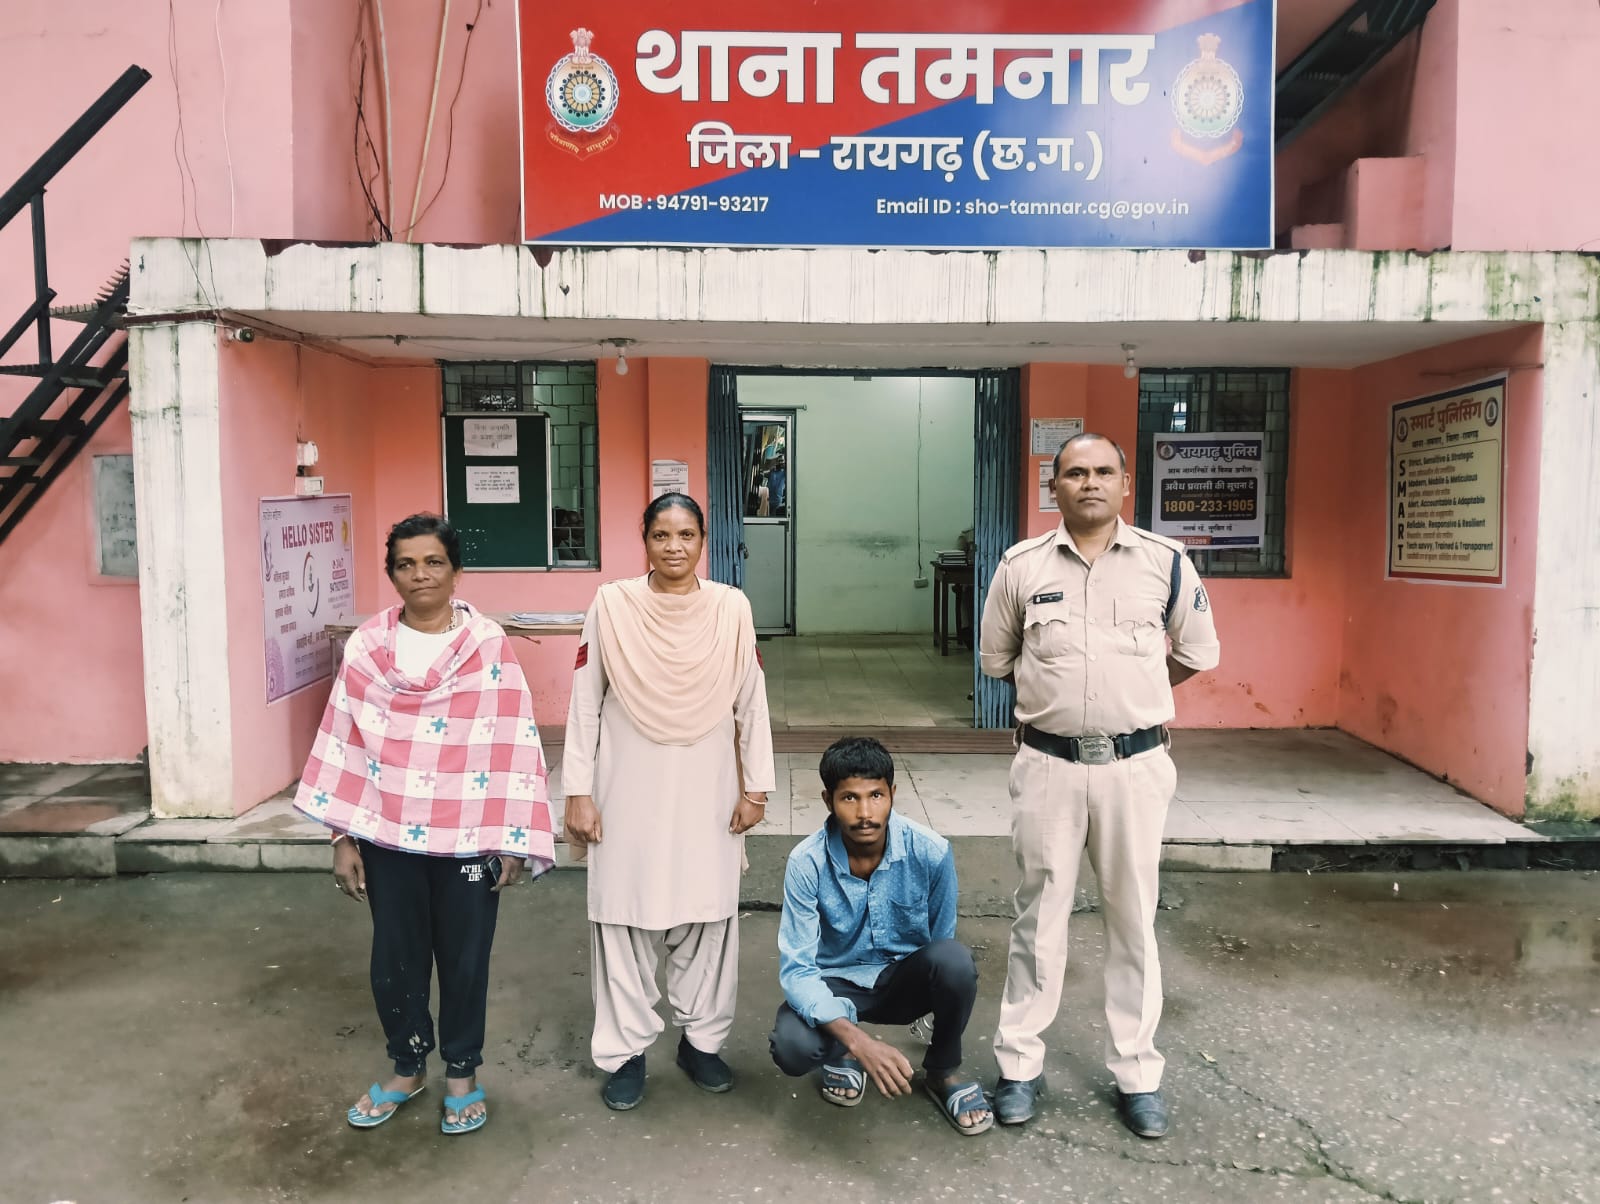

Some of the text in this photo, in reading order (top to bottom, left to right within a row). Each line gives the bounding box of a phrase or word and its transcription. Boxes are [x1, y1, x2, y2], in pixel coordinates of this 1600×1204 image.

[635, 29, 1156, 105] थाना तमनार
[686, 121, 792, 170] जिला
[830, 136, 963, 183] रायगढ़
[972, 130, 1103, 181] (छ.ग.)
[599, 193, 643, 210] MOB
[656, 194, 769, 212] 94791-93217
[876, 198, 929, 214] Email
[933, 200, 951, 214] ID
[965, 198, 1189, 219] sho-tamnar.cg@gov.in
[1180, 443, 1258, 461] रायगढ़ पुलिस
[1164, 500, 1254, 513] 1800-233-1905
[282, 521, 335, 549] HELLO SISTER
[460, 864, 483, 874] ATHL
